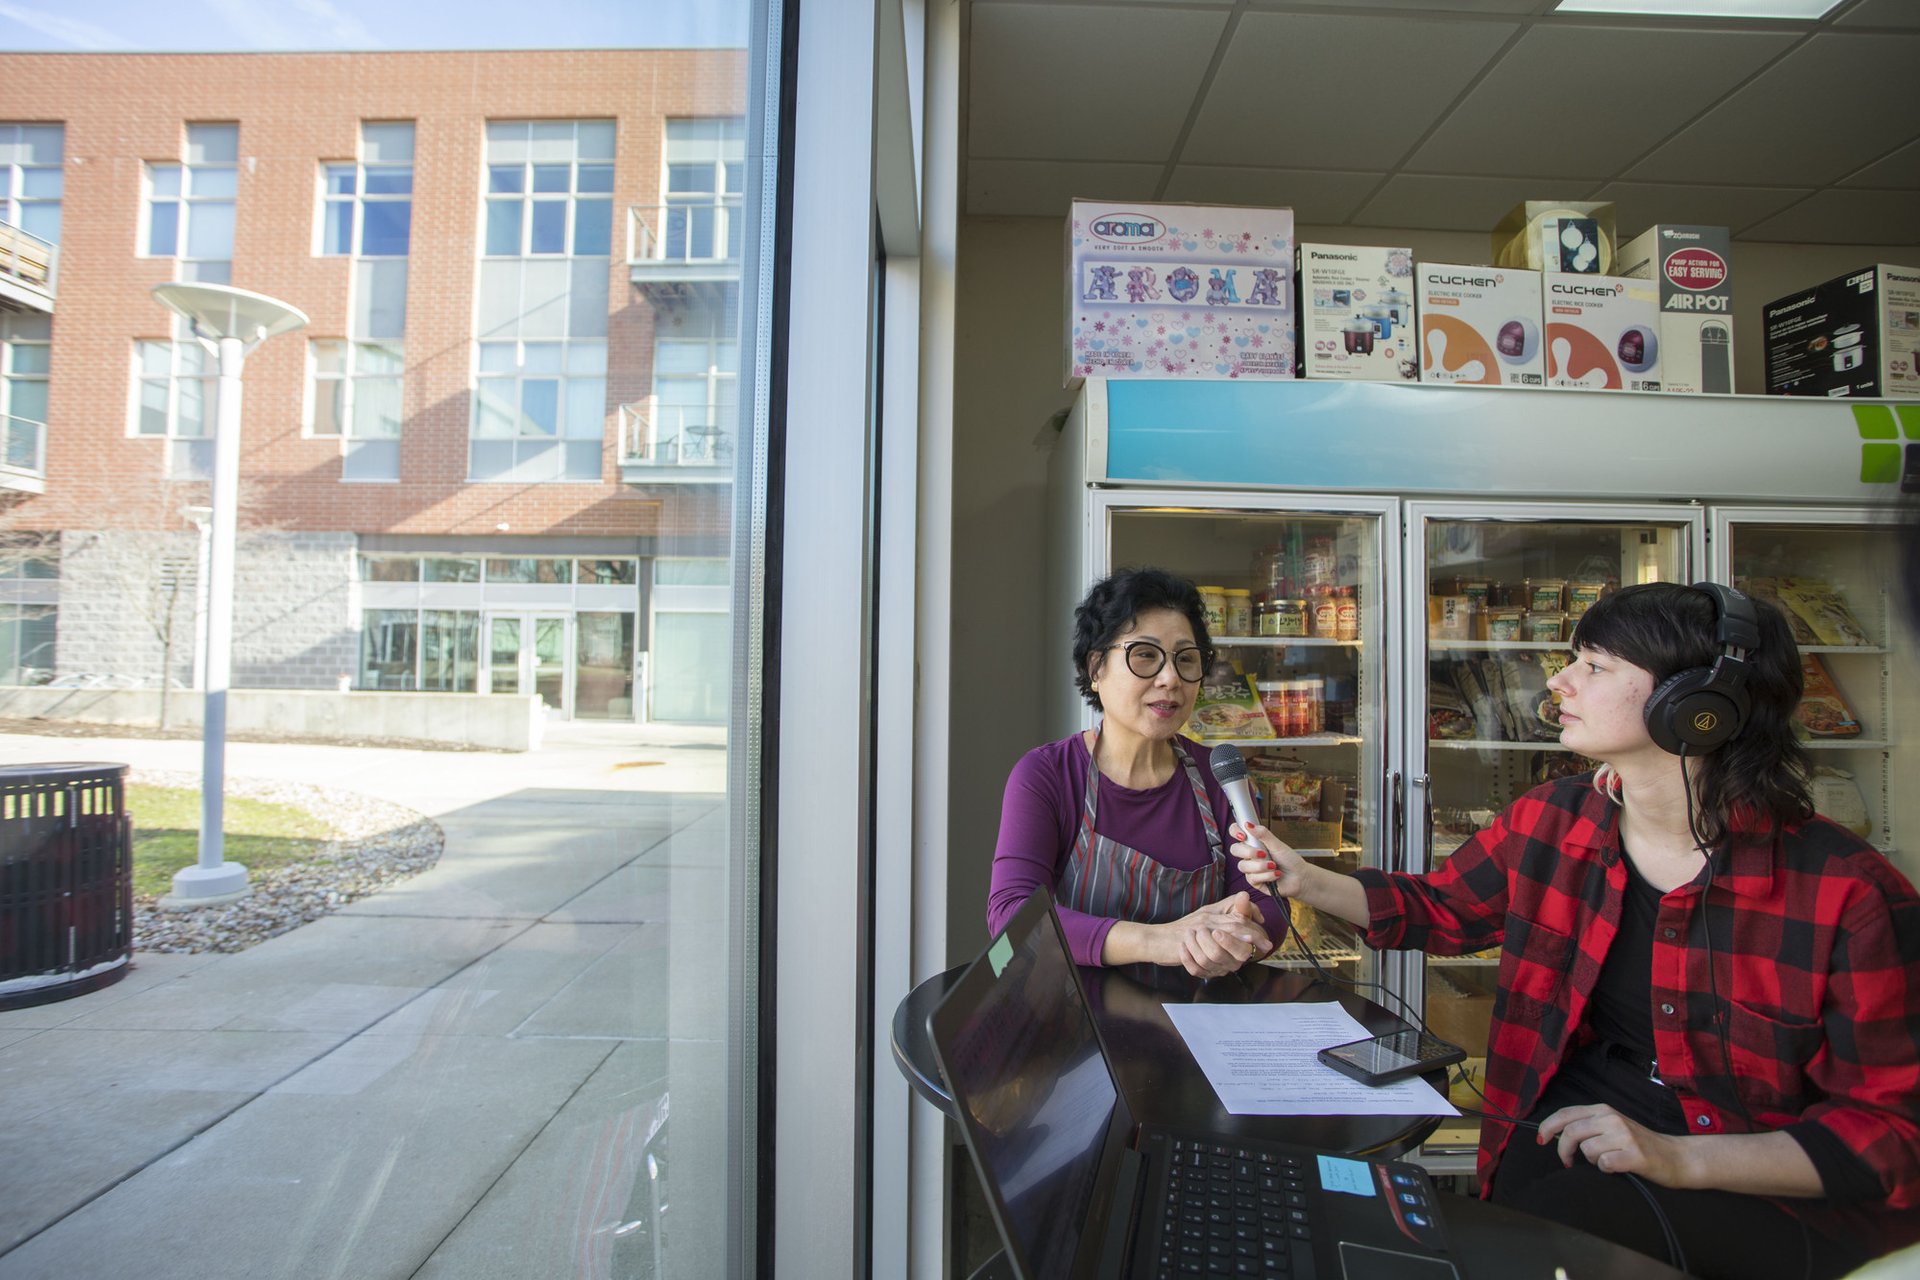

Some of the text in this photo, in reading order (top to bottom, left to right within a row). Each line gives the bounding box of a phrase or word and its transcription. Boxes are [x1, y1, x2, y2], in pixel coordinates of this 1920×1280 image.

[1094, 221, 1154, 237] aroma
[1311, 252, 1358, 261] Panasonic
[1668, 266, 1723, 279] EASY SERVING
[1428, 274, 1496, 287] CUCHEN
[1552, 284, 1616, 297] CUCHEN
[1665, 294, 1729, 311] AIR POT
[1769, 297, 1816, 318] Panasonic
[1523, 374, 1528, 383] 6
[1643, 382, 1648, 391] 6
